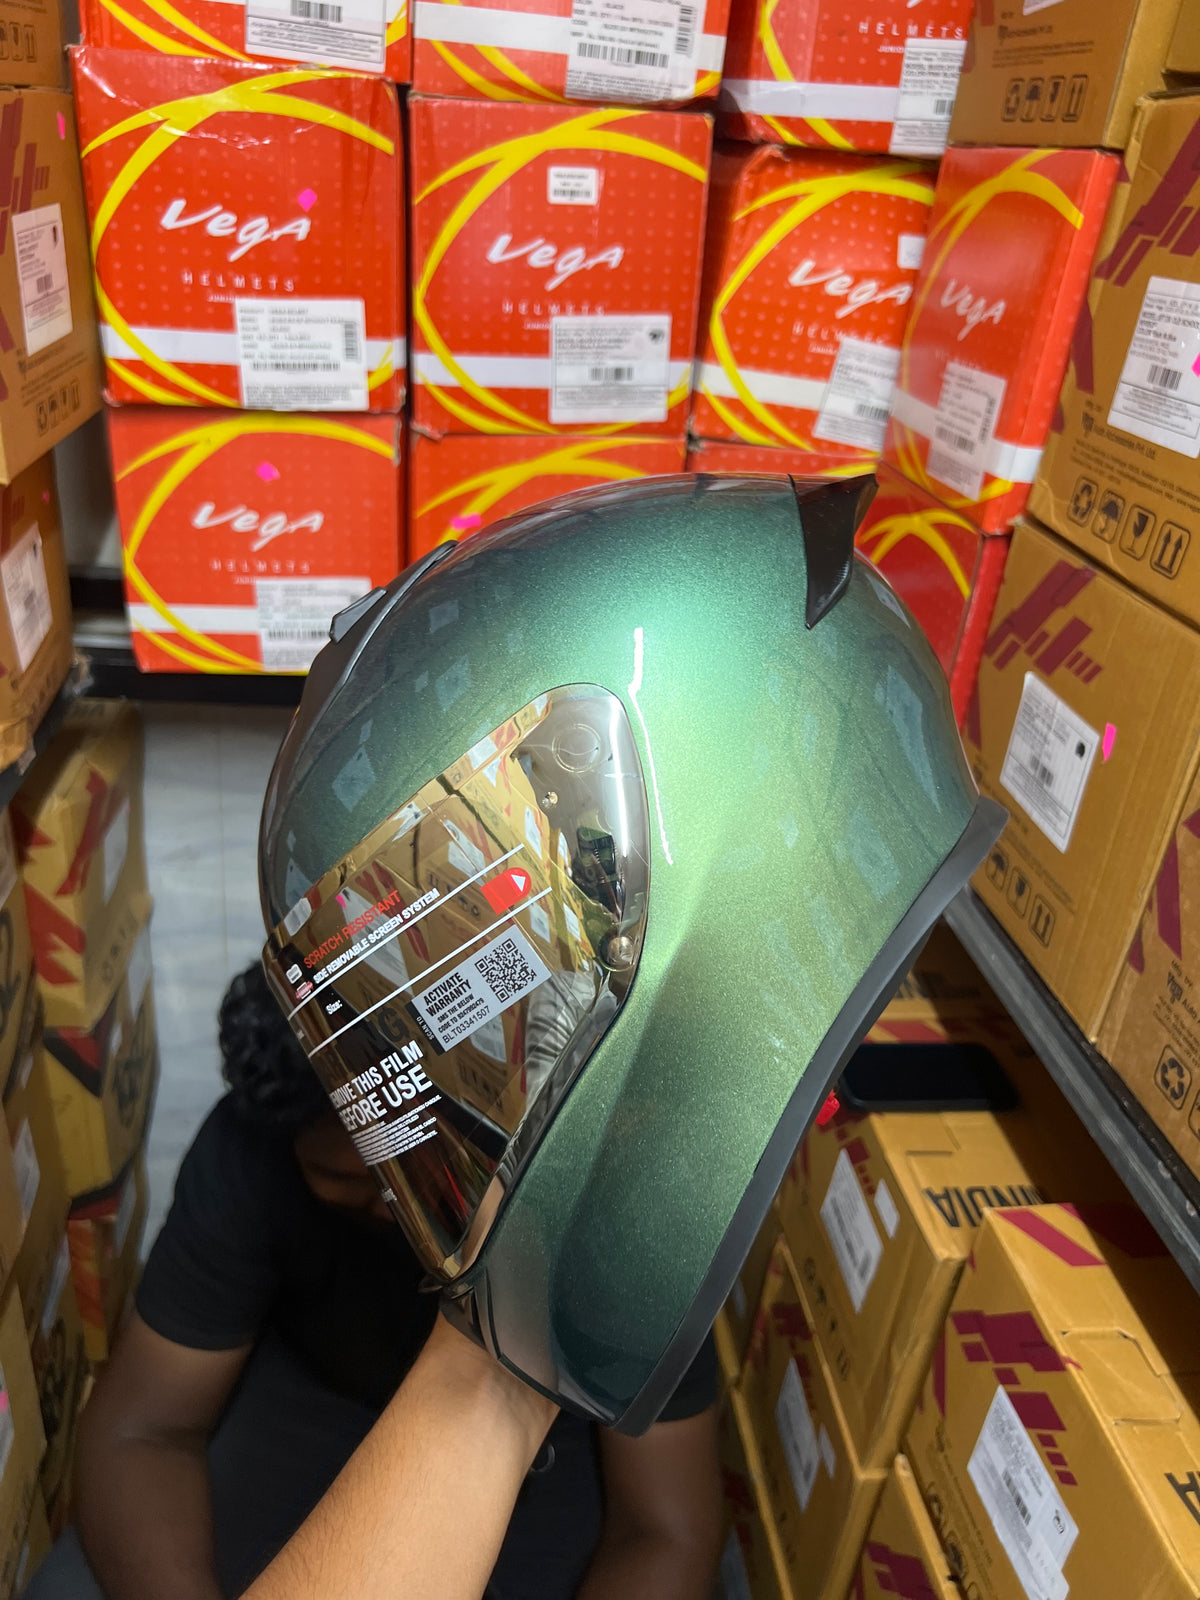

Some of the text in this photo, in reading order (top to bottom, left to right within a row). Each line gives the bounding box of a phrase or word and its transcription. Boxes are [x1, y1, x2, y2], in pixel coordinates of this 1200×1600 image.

[859, 21, 963, 39] HELMETS
[182, 271, 294, 292] HELMETS
[209, 559, 310, 573] HELMETS
[303, 890, 401, 969] SCRATCH RESISTANT
[313, 967, 330, 984] SIDE
[326, 938, 371, 976] REMOVABLE
[368, 913, 404, 943] SCREEN
[401, 887, 440, 919] SYSTEM
[423, 972, 463, 1006] ACTIVATE
[426, 979, 472, 1017] WARRANTY
[437, 993, 474, 1023] SMS THE BELOW
[438, 1021, 451, 1033] CODE
[450, 1016, 458, 1025] TO
[442, 1005, 490, 1044] BLT03341507
[416, 1016, 435, 1040] SCAN TO
[351, 1066, 383, 1095] THIS
[380, 1040, 424, 1078] FILM
[381, 1063, 433, 1108] USE
